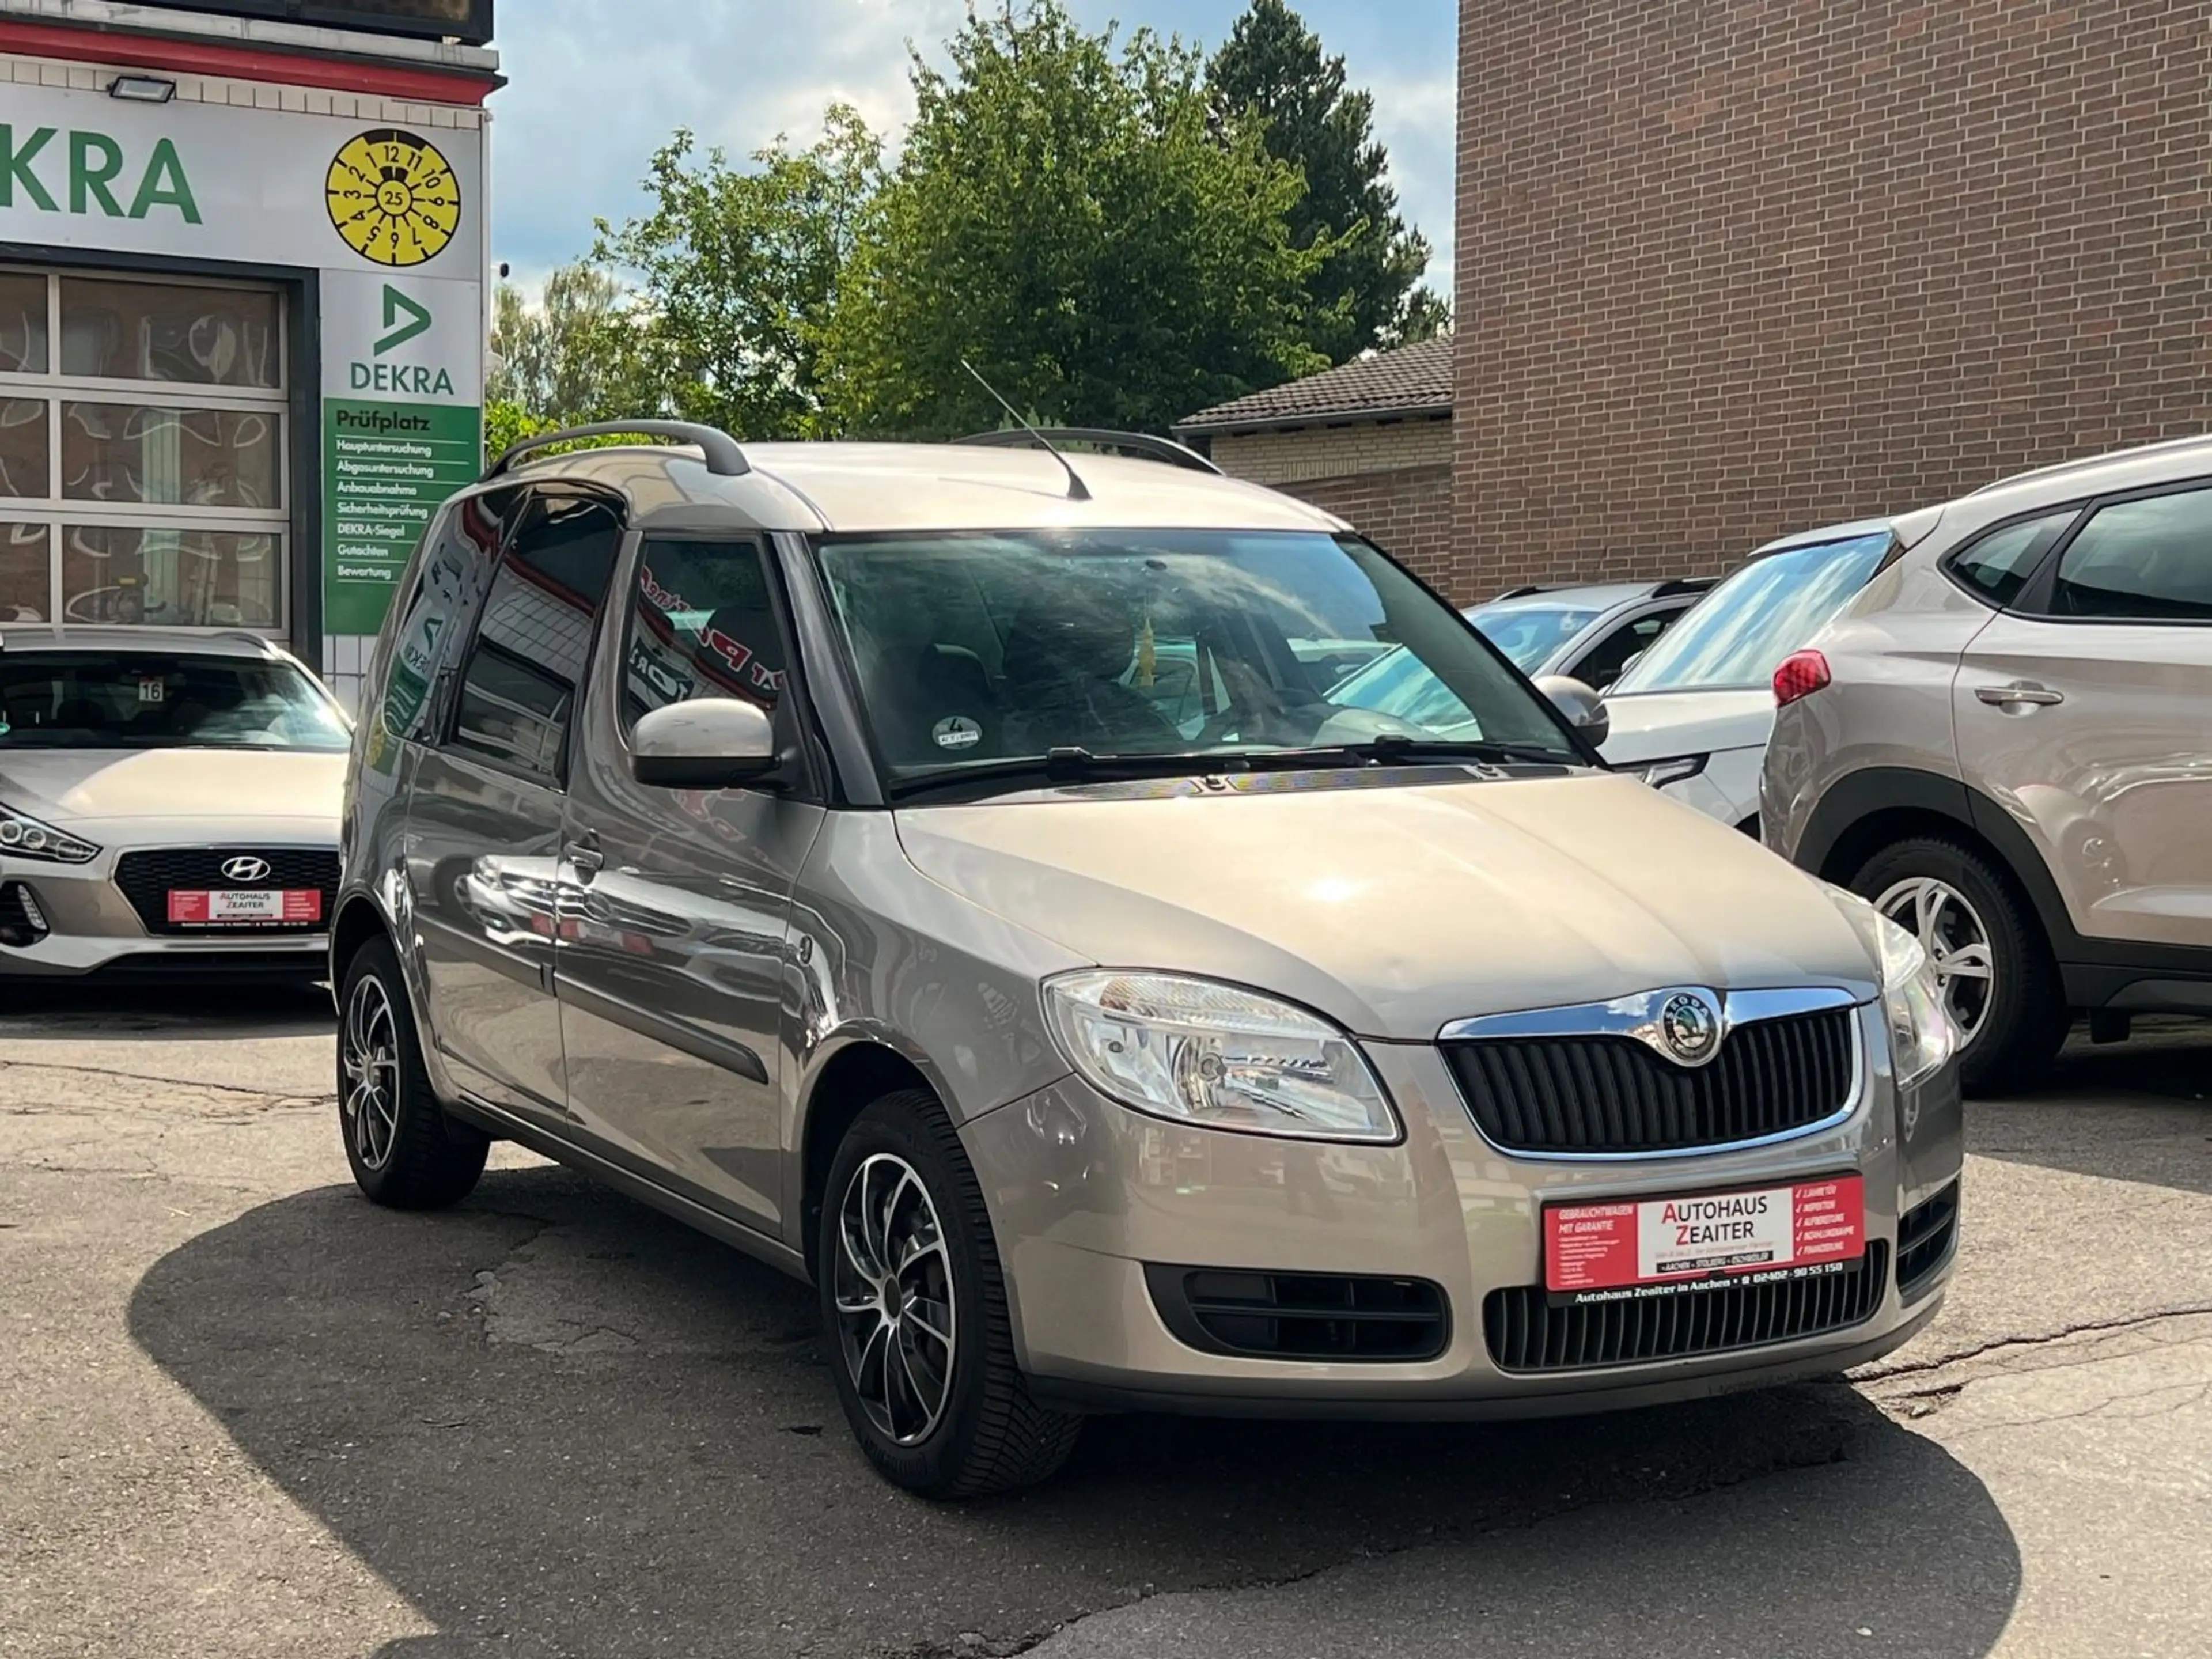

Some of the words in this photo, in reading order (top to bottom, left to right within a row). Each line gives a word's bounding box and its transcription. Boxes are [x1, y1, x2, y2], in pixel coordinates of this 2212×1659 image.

[365, 151, 377, 168] 1
[384, 145, 399, 162] 12
[407, 151, 423, 171] 11
[349, 166, 366, 182] 2
[422, 169, 441, 189] 10
[343, 190, 361, 199] 3
[384, 191, 403, 206] 25
[428, 197, 445, 206] 9
[350, 210, 365, 221] 4
[423, 215, 439, 229] 8
[367, 226, 381, 242] 5
[390, 232, 399, 249] 6
[412, 227, 421, 245] 7
[351, 362, 454, 395] DEKRA
[336, 409, 430, 434] Prüfplatz
[336, 439, 432, 458] Hauptuntersuchung
[336, 460, 434, 479] Abgasuntersuchung
[337, 481, 417, 496] Anbauabnahme
[337, 502, 428, 520] Sicherheitsprüfung
[337, 523, 405, 539] DEKRA-Siegel
[337, 544, 389, 557] Gutachten
[337, 565, 392, 581] Bewertung
[143, 684, 160, 699] 16
[1661, 1195, 1768, 1224] AUTOHAUS
[1676, 1220, 1755, 1246] ZEAITER
[1575, 1289, 1633, 1304] Autohaus
[1634, 1285, 1676, 1297] Zeaiter
[1677, 1283, 1688, 1293] in
[1690, 1278, 1730, 1292] Aachen
[1809, 1264, 1823, 1275] 55
